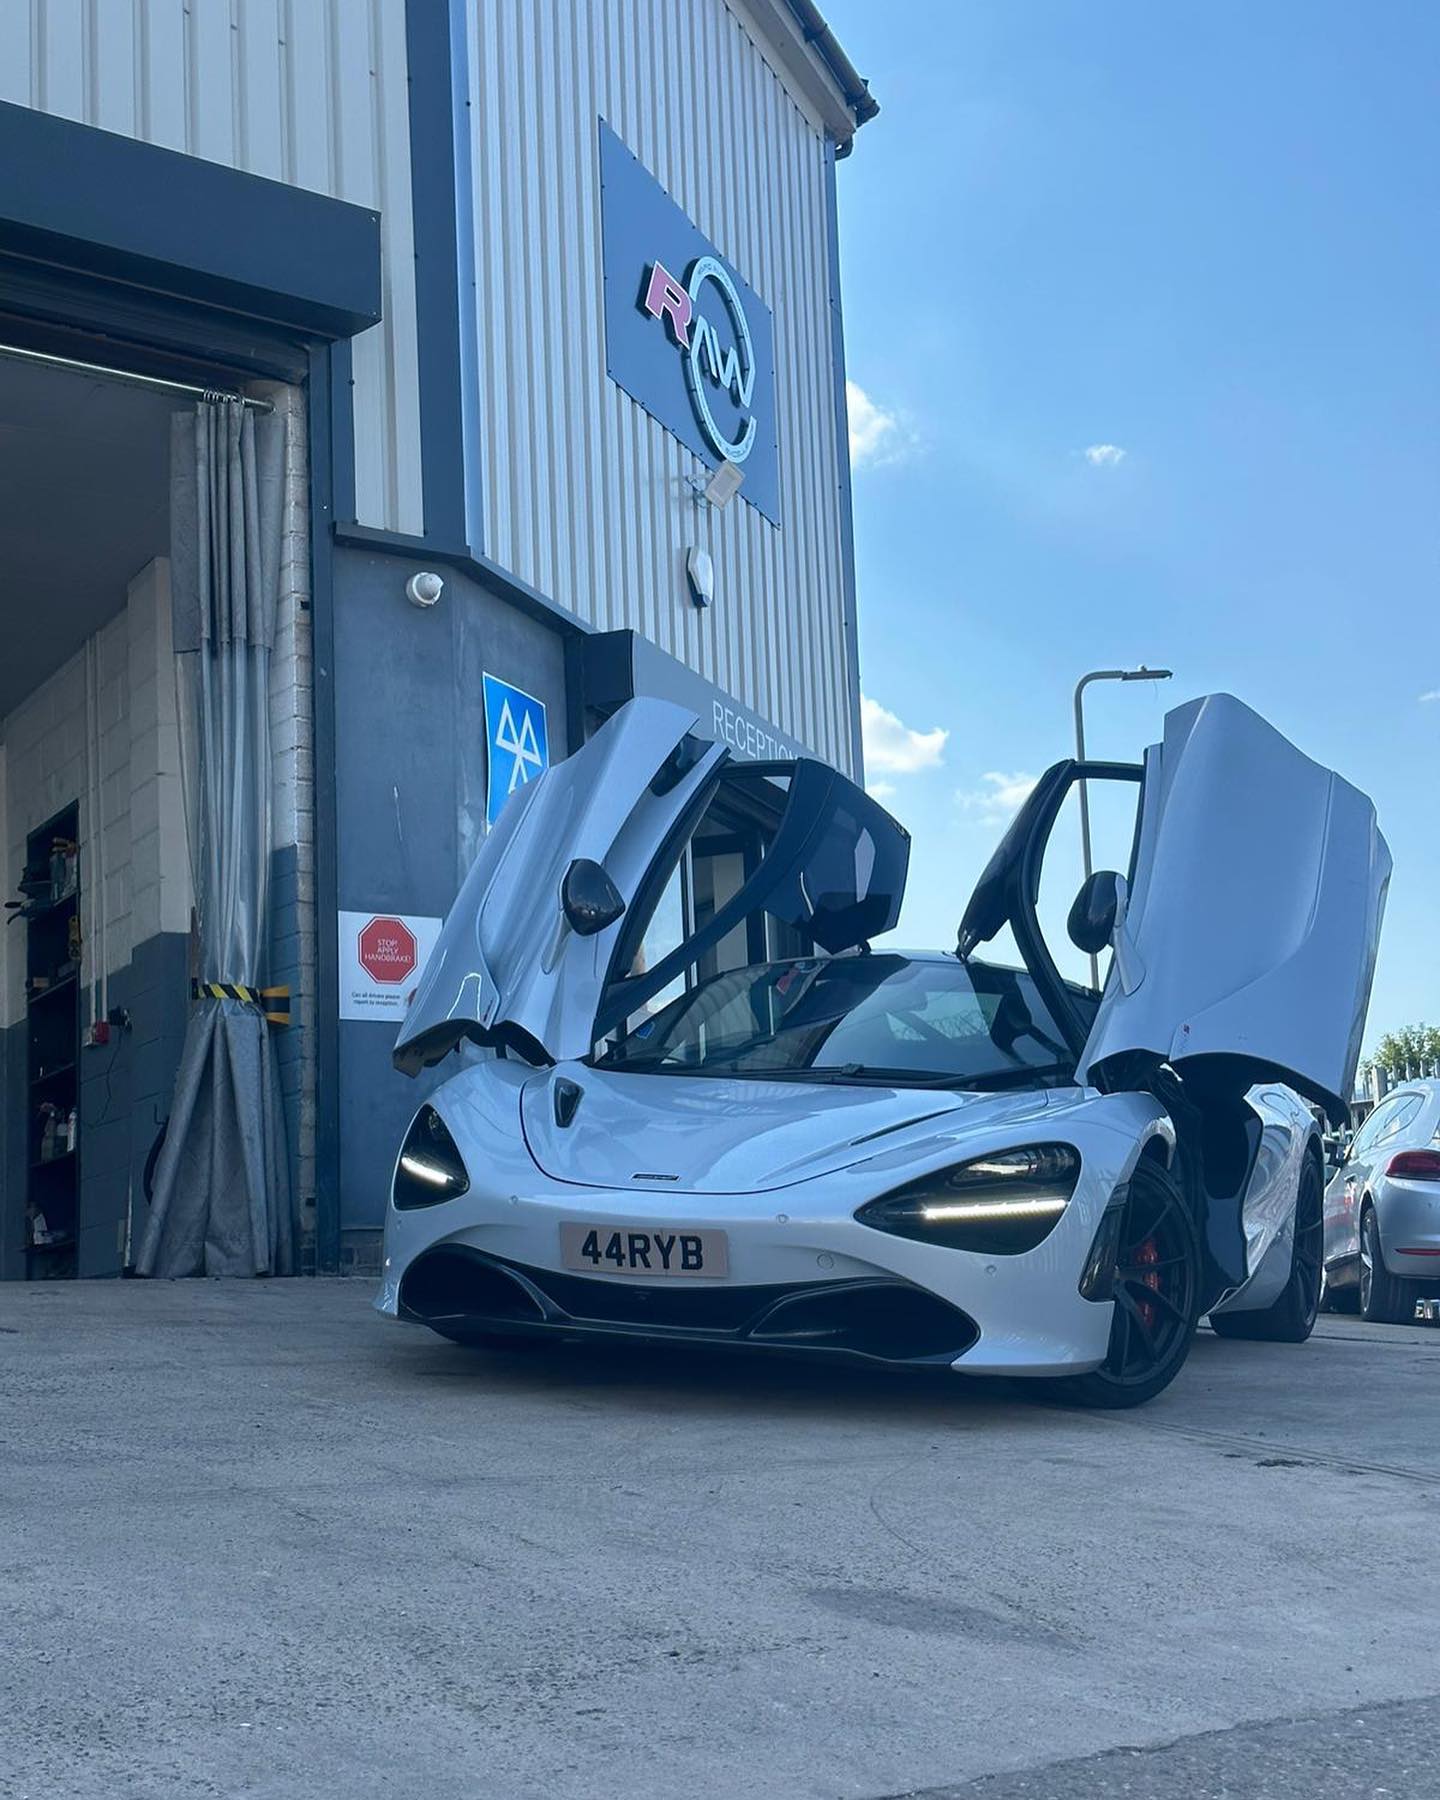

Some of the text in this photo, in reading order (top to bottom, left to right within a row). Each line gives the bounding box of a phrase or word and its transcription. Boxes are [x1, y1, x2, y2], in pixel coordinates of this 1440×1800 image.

[645, 260, 757, 408] RAW
[713, 700, 799, 760] RECEPTIO
[582, 1230, 703, 1270] 44RYB
